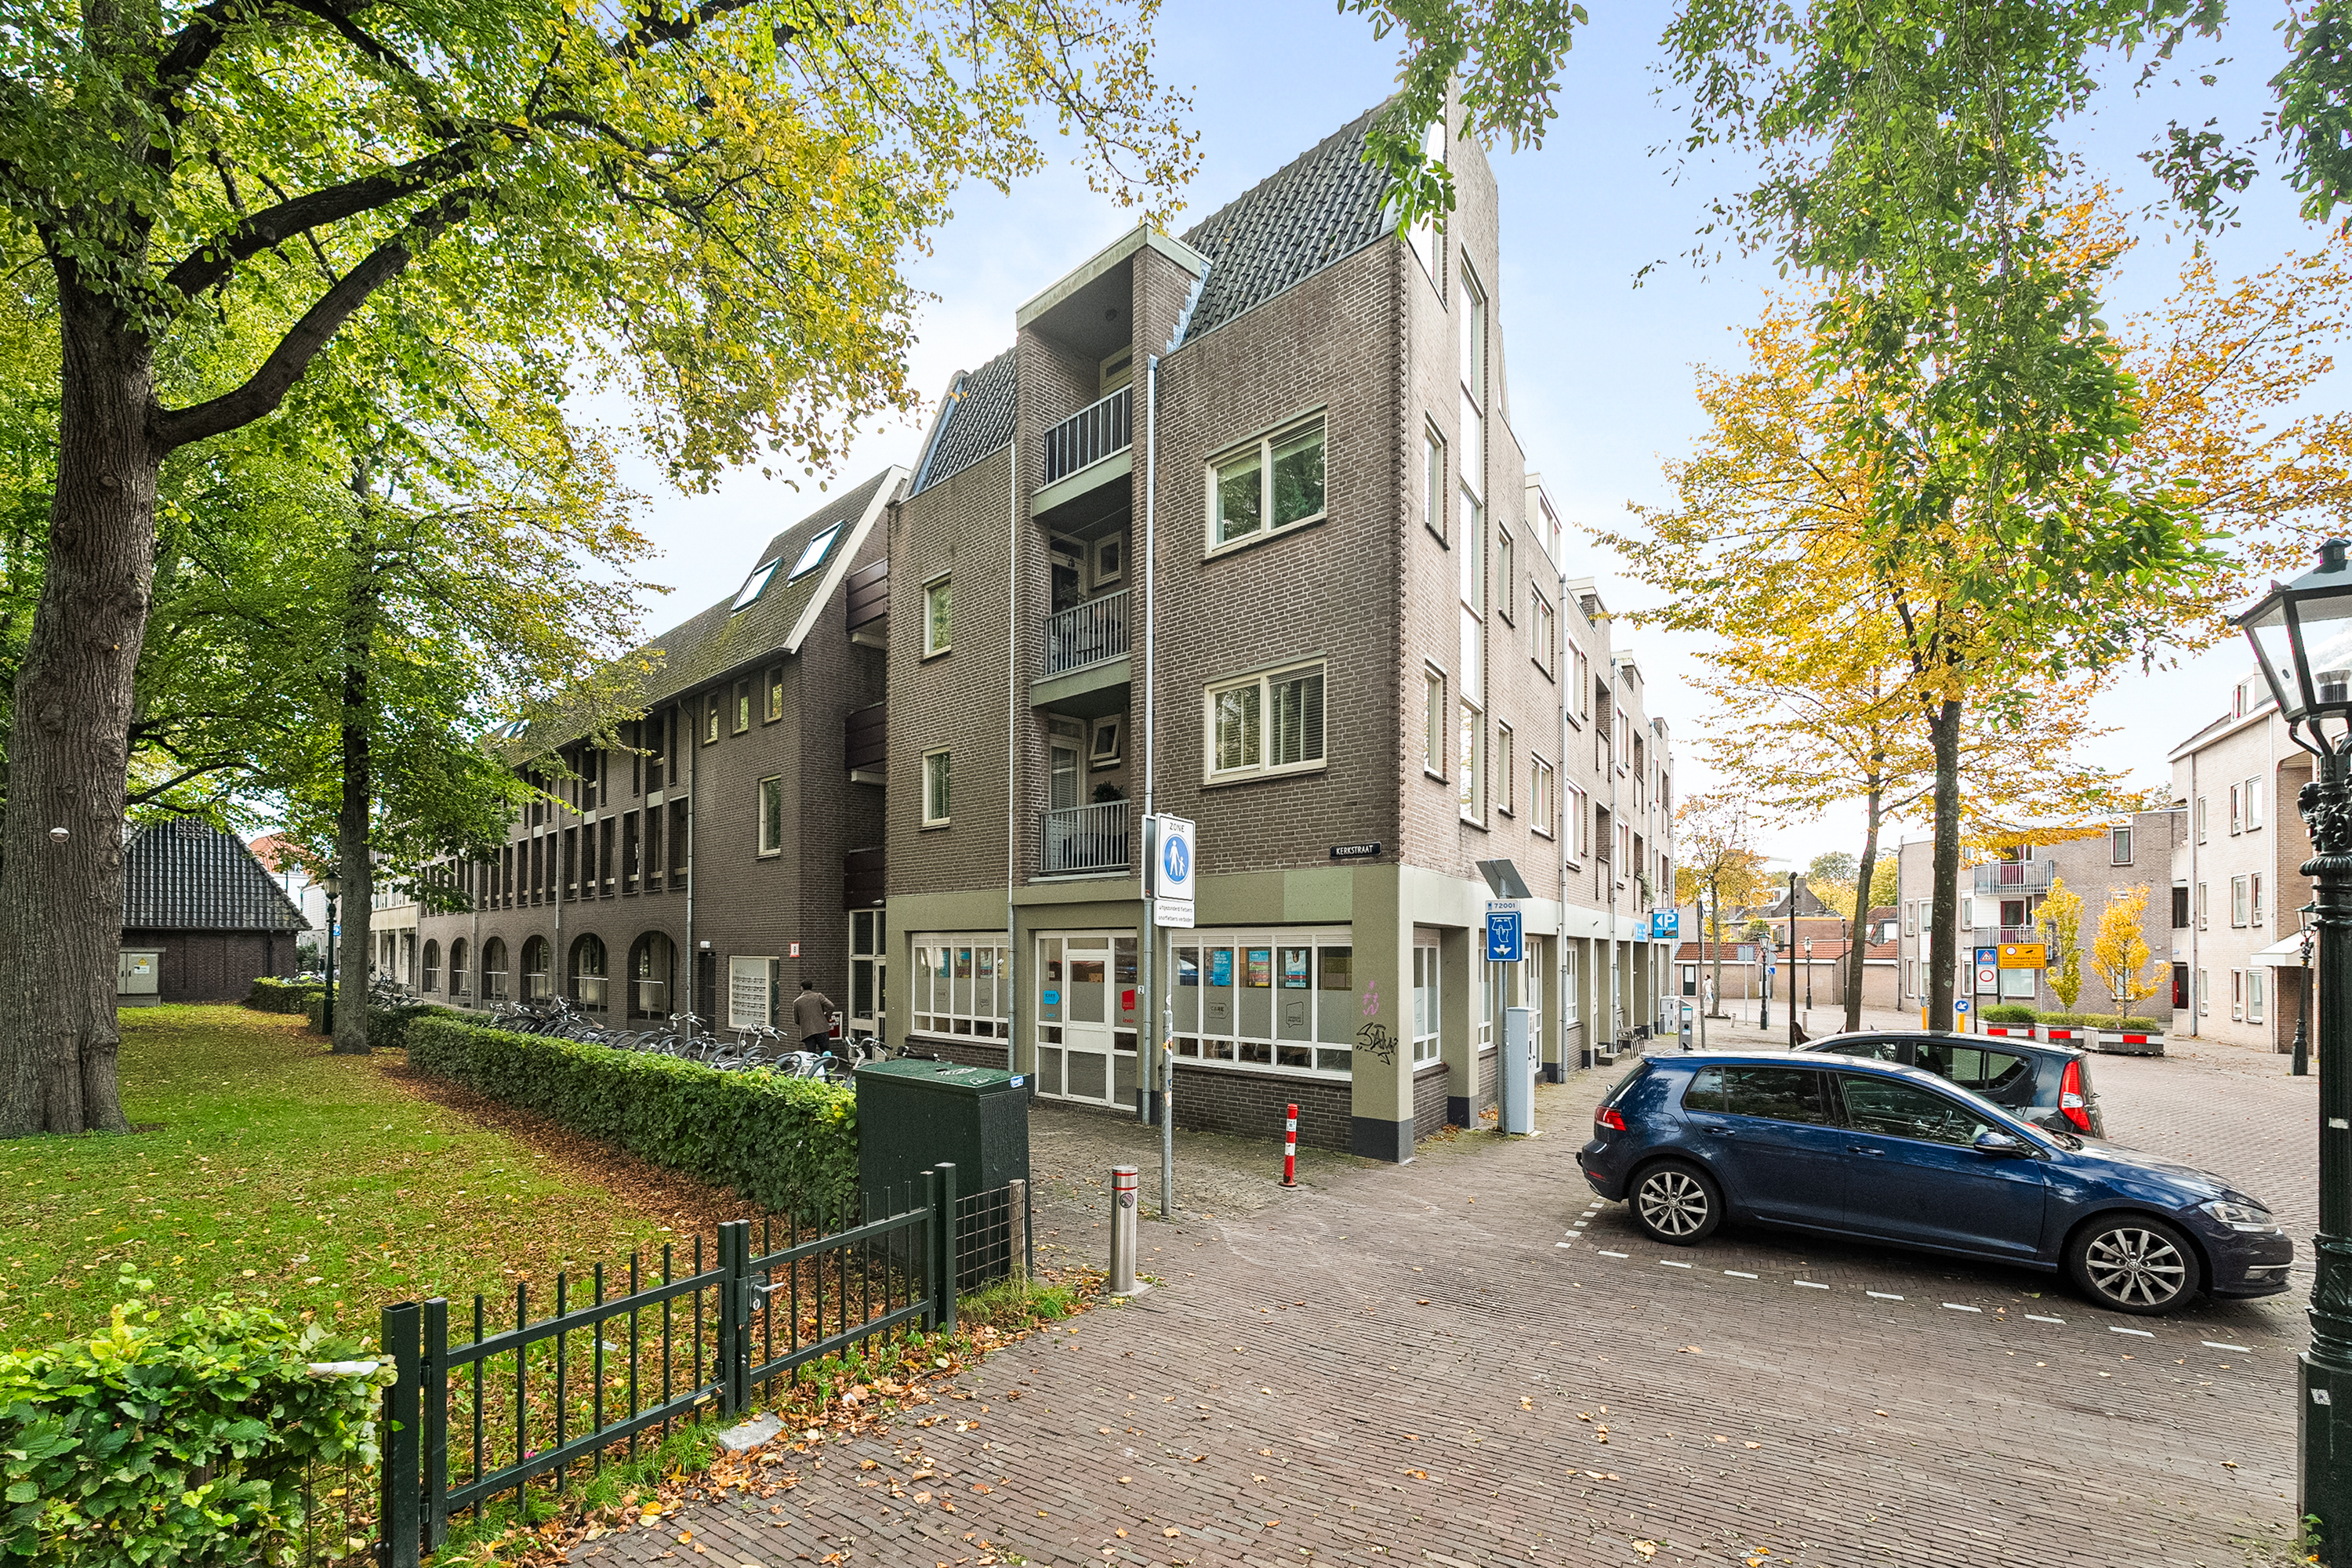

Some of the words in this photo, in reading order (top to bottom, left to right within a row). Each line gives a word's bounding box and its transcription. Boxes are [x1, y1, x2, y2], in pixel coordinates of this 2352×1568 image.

[1169, 822, 1185, 833] ZONE
[1336, 844, 1374, 855] KERKSTRAAT
[1664, 914, 1675, 927] P
